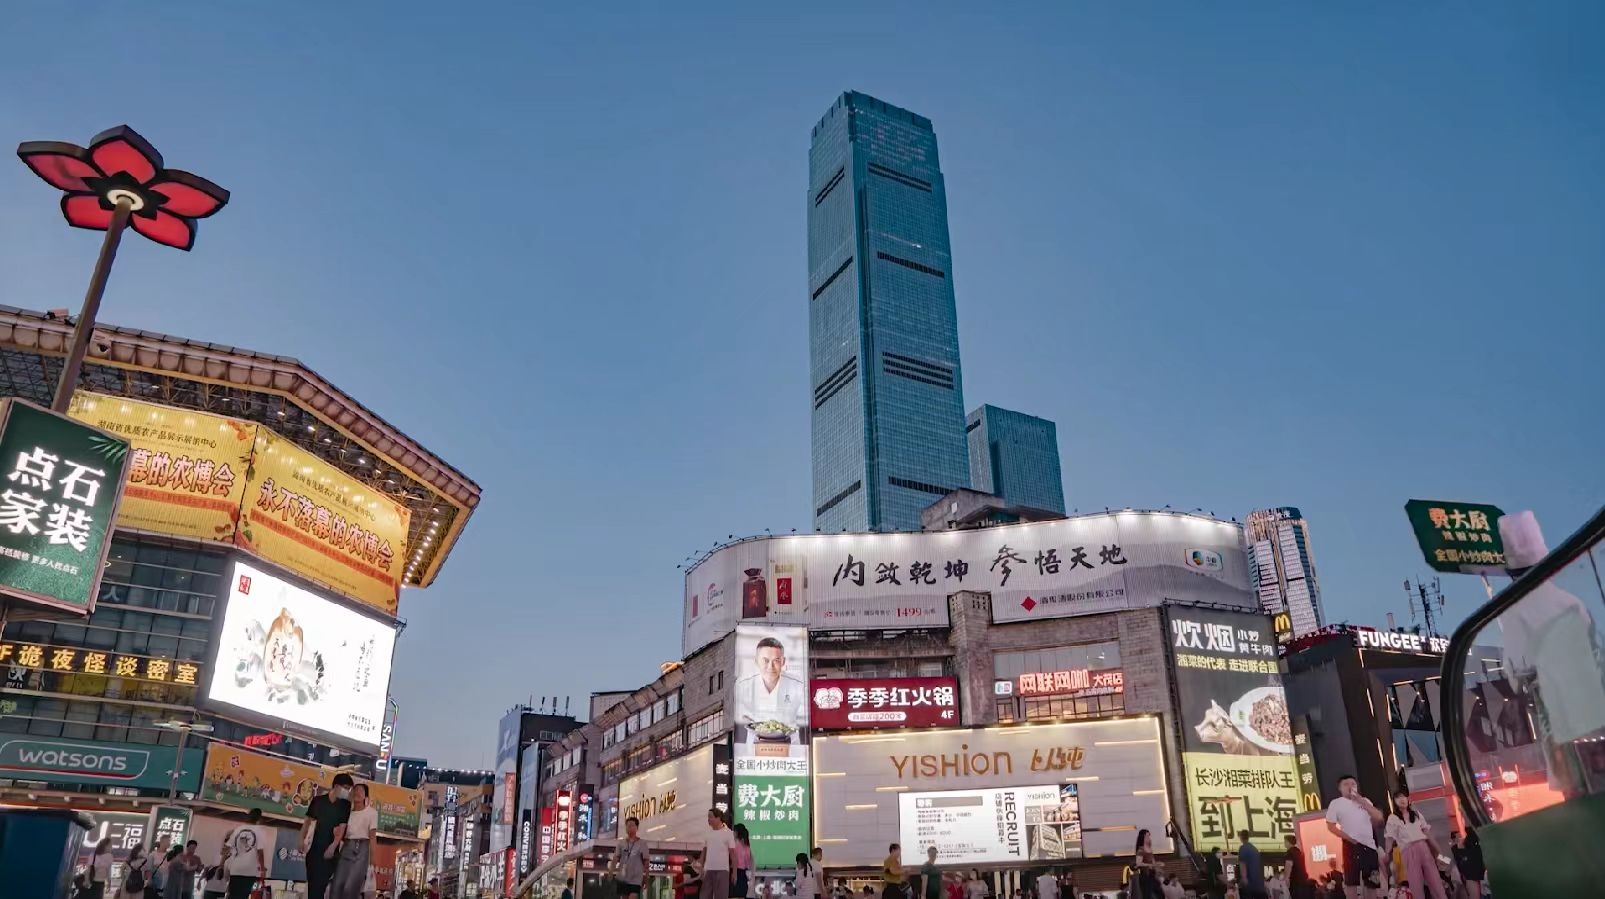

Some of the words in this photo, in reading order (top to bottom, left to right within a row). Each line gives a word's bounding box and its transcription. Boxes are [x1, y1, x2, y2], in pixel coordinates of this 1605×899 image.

[7, 446, 106, 507] 点石
[0, 489, 94, 553] 家装
[256, 477, 395, 571] 永不落幕的农博会
[1428, 507, 1491, 531] 费大厨
[897, 607, 922, 618] 1499
[1172, 618, 1236, 652] 炊烟
[1237, 629, 1259, 642] 小炒
[1358, 630, 1422, 650] FUNGEE
[1239, 642, 1274, 656] 黄牛肉
[0, 645, 13, 660] F
[18, 645, 199, 685] 诡夜怪谈密室
[1177, 653, 1227, 670] 湘菜的代表
[1228, 658, 1279, 673] 走进联合国
[1019, 669, 1090, 694] 网联网咖
[847, 686, 954, 708] 季季红火锅
[941, 710, 955, 719] 4F
[18, 747, 128, 771] watsons
[736, 759, 807, 771] 全国小炒肉大王
[1295, 733, 1314, 785] 麦当劳
[1195, 768, 1296, 789] 长沙湘菜排队王
[737, 783, 805, 808] 费大厨
[158, 817, 186, 832] 点石
[743, 809, 800, 822] 辣椒炒肉
[1004, 792, 1020, 857] RECRUIT
[1198, 795, 1297, 839] 到上海
[521, 821, 531, 866] CONVERSE
